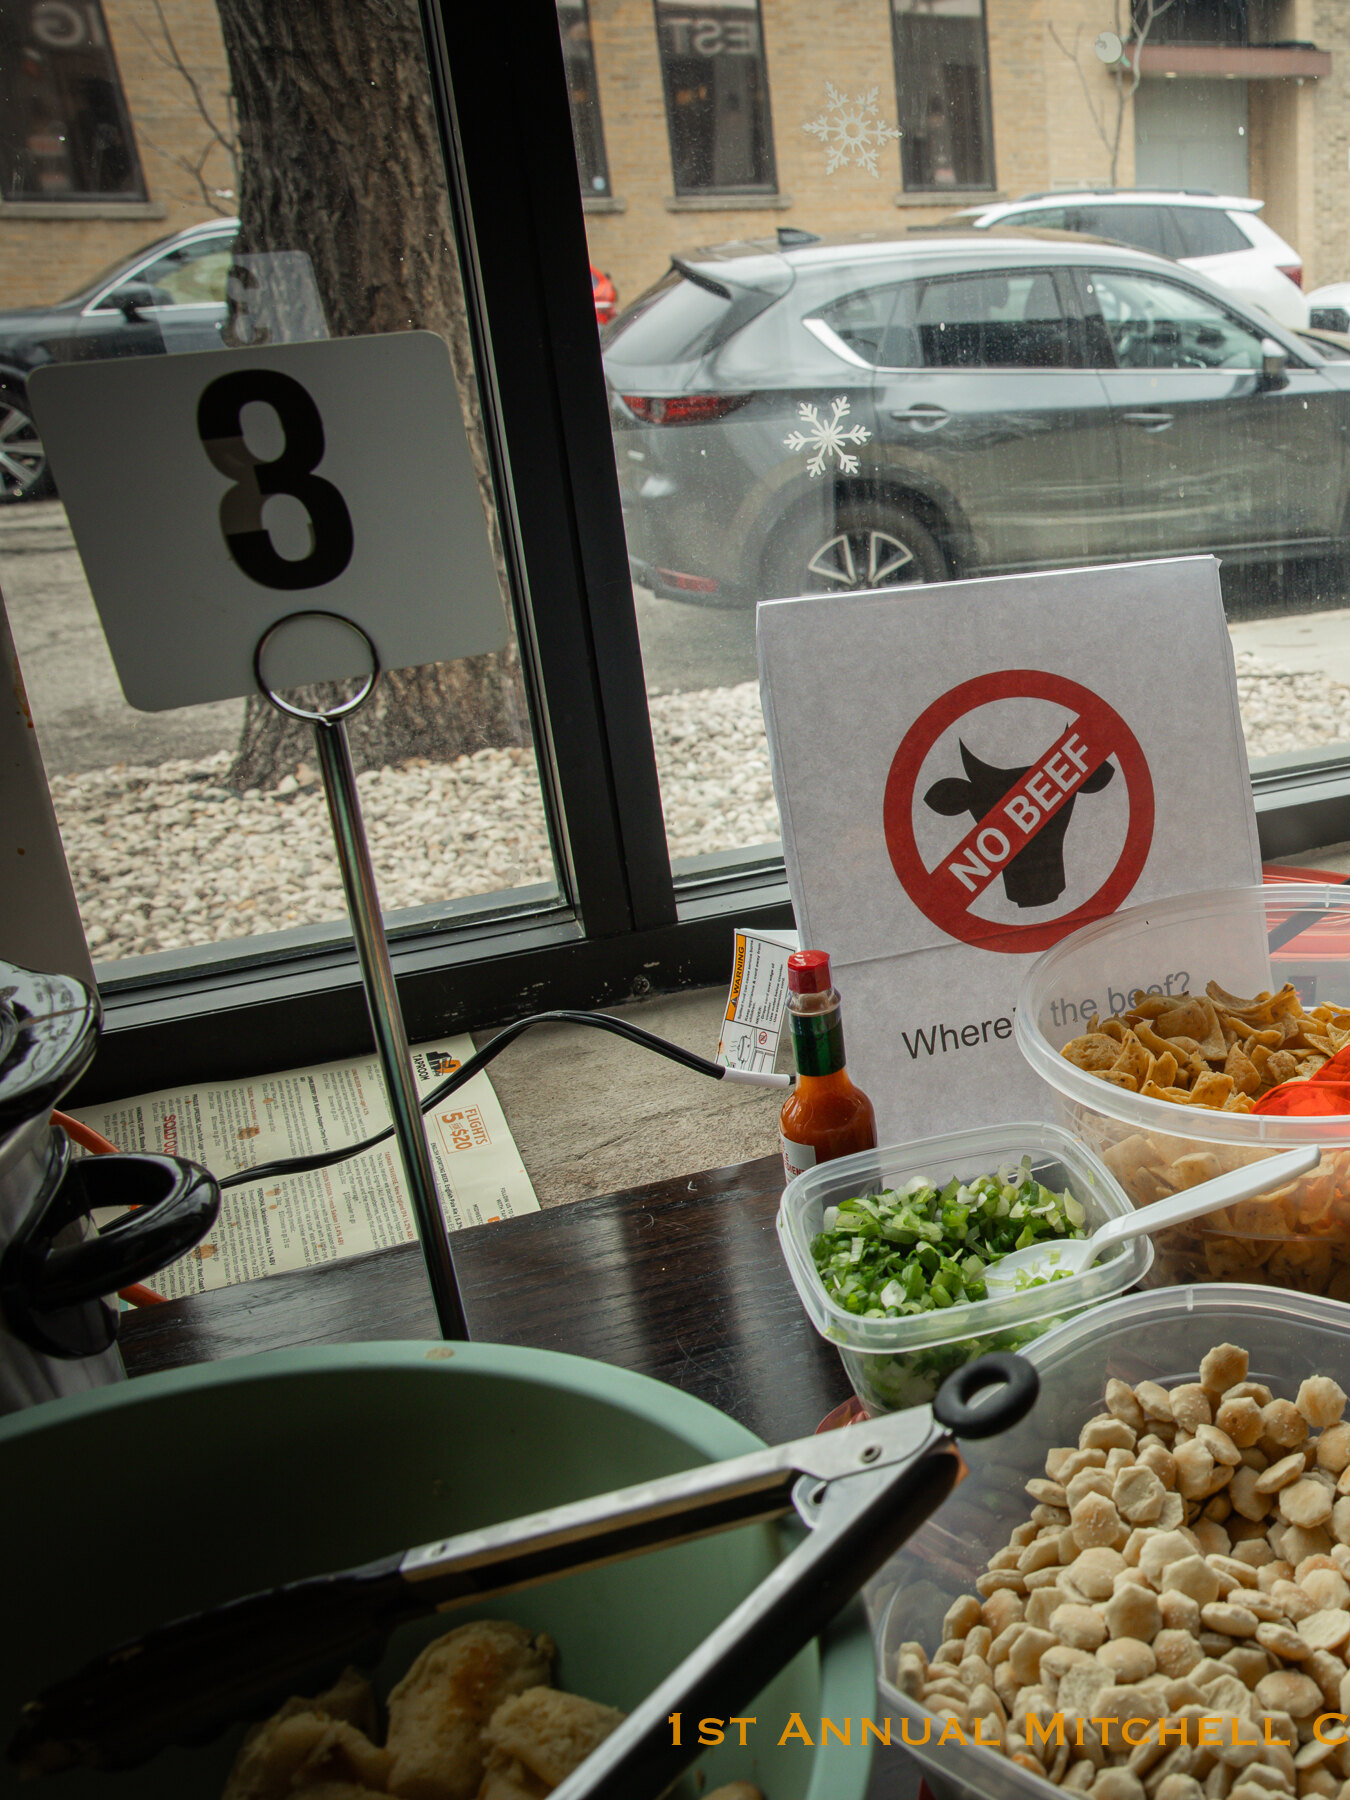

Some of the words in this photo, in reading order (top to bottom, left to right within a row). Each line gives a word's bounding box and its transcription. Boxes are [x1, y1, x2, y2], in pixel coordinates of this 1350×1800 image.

[948, 827, 1010, 893] NO
[1003, 734, 1089, 834] BEEF
[733, 945, 744, 992] WARNING
[1050, 998, 1098, 1027] the
[412, 1054, 430, 1081] TAPROOM
[163, 1113, 177, 1140] SOLD
[441, 1112, 464, 1123] 5
[465, 1108, 488, 1145] FLIGHTS
[449, 1128, 473, 1149] $20
